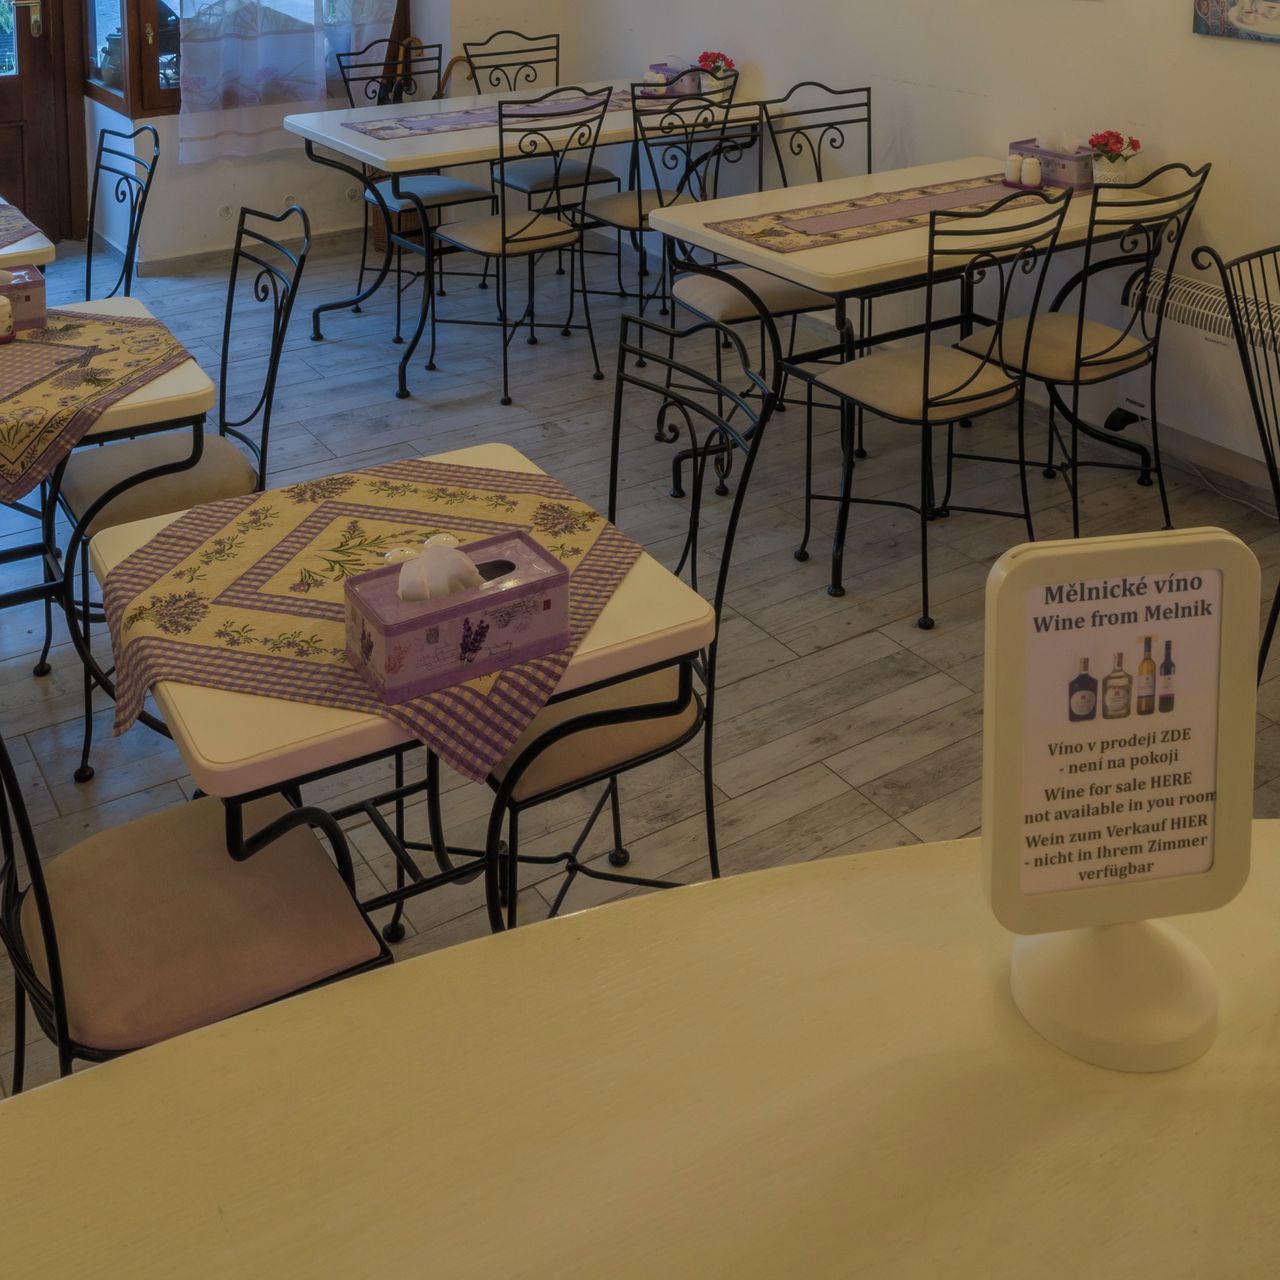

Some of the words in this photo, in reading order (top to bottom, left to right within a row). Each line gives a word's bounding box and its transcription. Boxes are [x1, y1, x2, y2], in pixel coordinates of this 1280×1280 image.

[1044, 576, 1148, 605] Mělnické
[1154, 573, 1203, 594] víno
[1033, 614, 1086, 633] Wine
[1091, 610, 1139, 628] from
[1144, 600, 1213, 622] Melnik
[1048, 741, 1083, 756] Víno
[1087, 742, 1097, 752] v
[1100, 732, 1157, 753] prodeji
[1160, 728, 1192, 743] ZDE
[1068, 757, 1104, 774] není
[1107, 758, 1126, 770] na
[1130, 748, 1179, 770] pokoji
[1044, 785, 1085, 802] Wine
[1089, 782, 1112, 798] for
[1115, 778, 1147, 794] sale
[1150, 772, 1193, 790] HERE
[1024, 810, 1051, 824] not
[1054, 800, 1125, 821] available
[1128, 799, 1143, 812] in
[1147, 795, 1175, 812] you
[1179, 791, 1217, 806] room
[1025, 832, 1065, 848] Wein
[1069, 830, 1102, 844] zum
[1106, 819, 1168, 838] Verkauf
[1170, 814, 1208, 831] HIER
[1033, 851, 1074, 868] nicht
[1077, 849, 1092, 862] in
[1096, 844, 1144, 860] Ihrem
[1147, 834, 1209, 853] Zimmer
[1078, 861, 1155, 881] verfügbar
